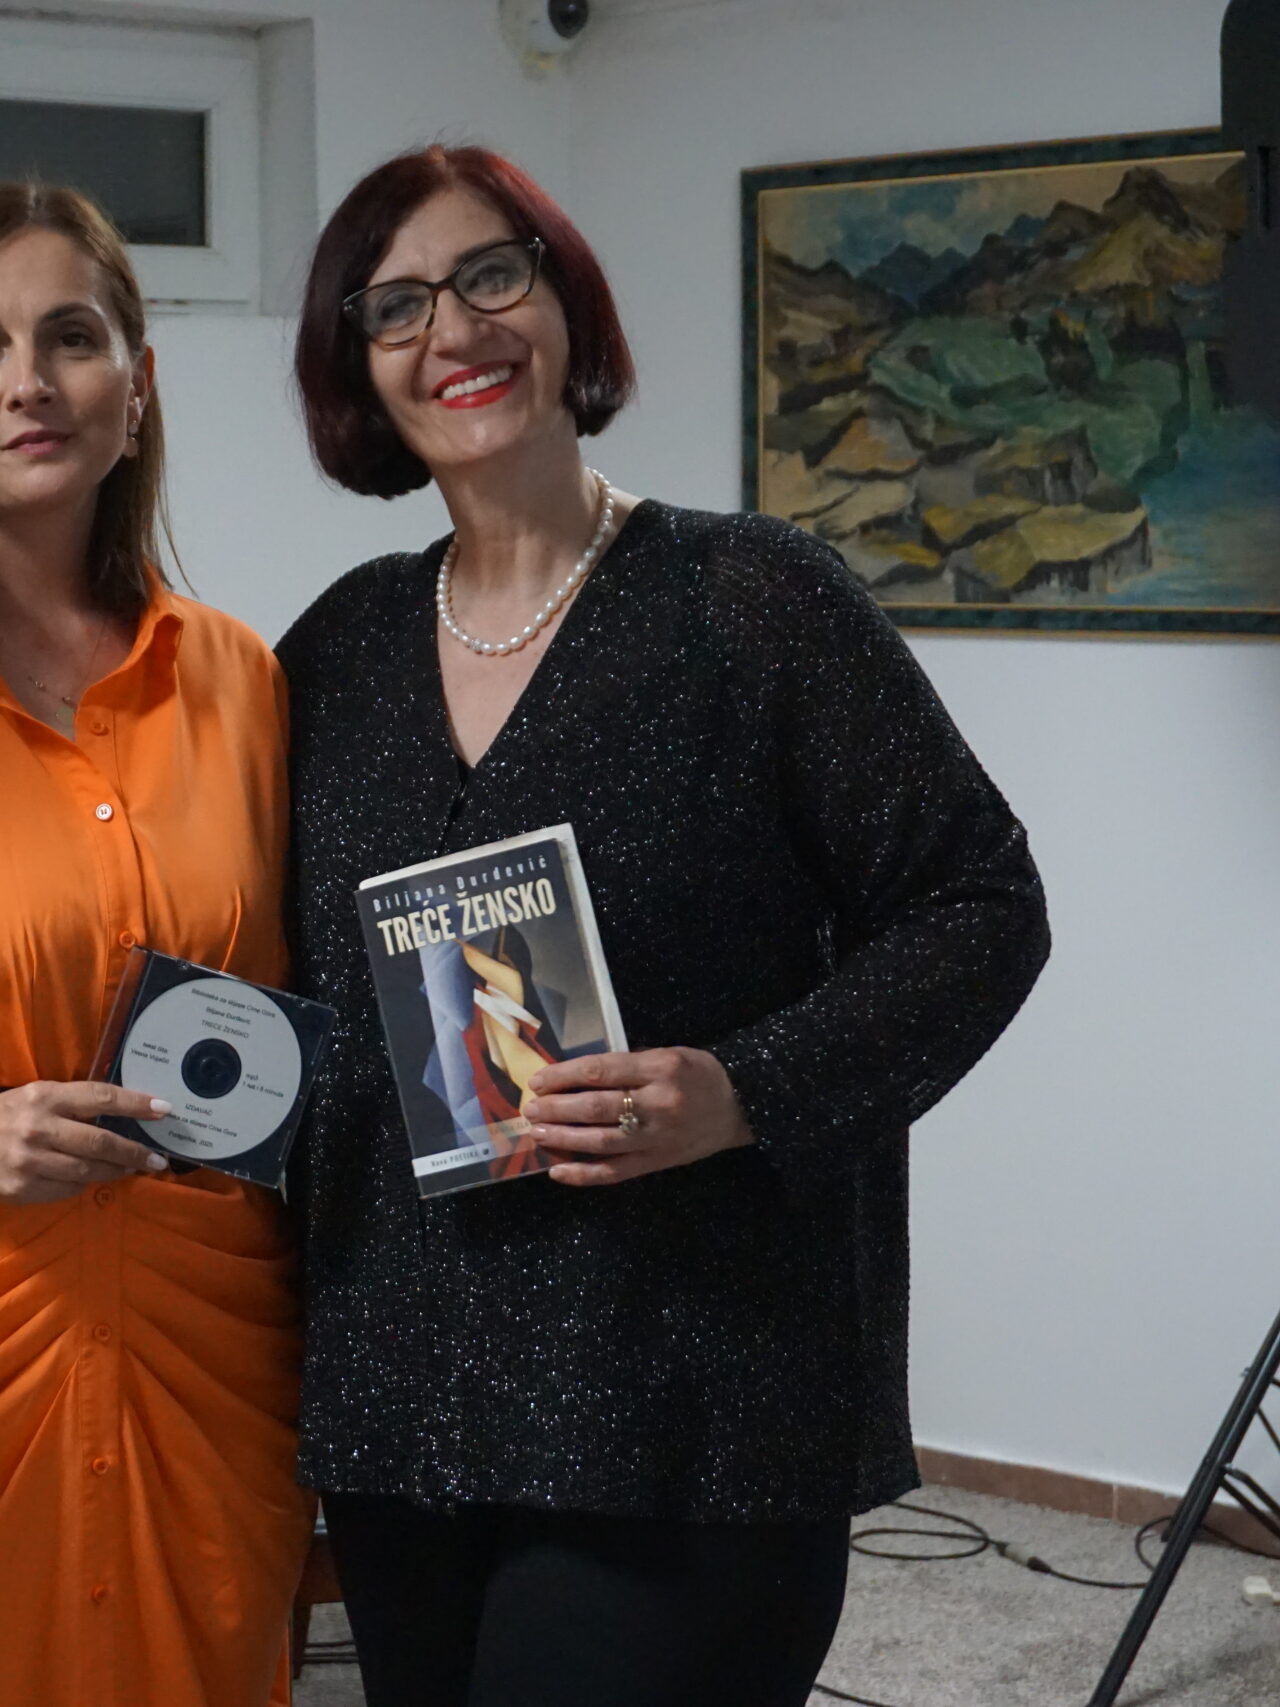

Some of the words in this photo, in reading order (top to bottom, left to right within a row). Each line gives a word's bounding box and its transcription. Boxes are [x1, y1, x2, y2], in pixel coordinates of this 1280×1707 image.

[373, 883, 446, 912] Biljana
[377, 900, 456, 956] TREĆE
[456, 878, 557, 936] ŽENSKO
